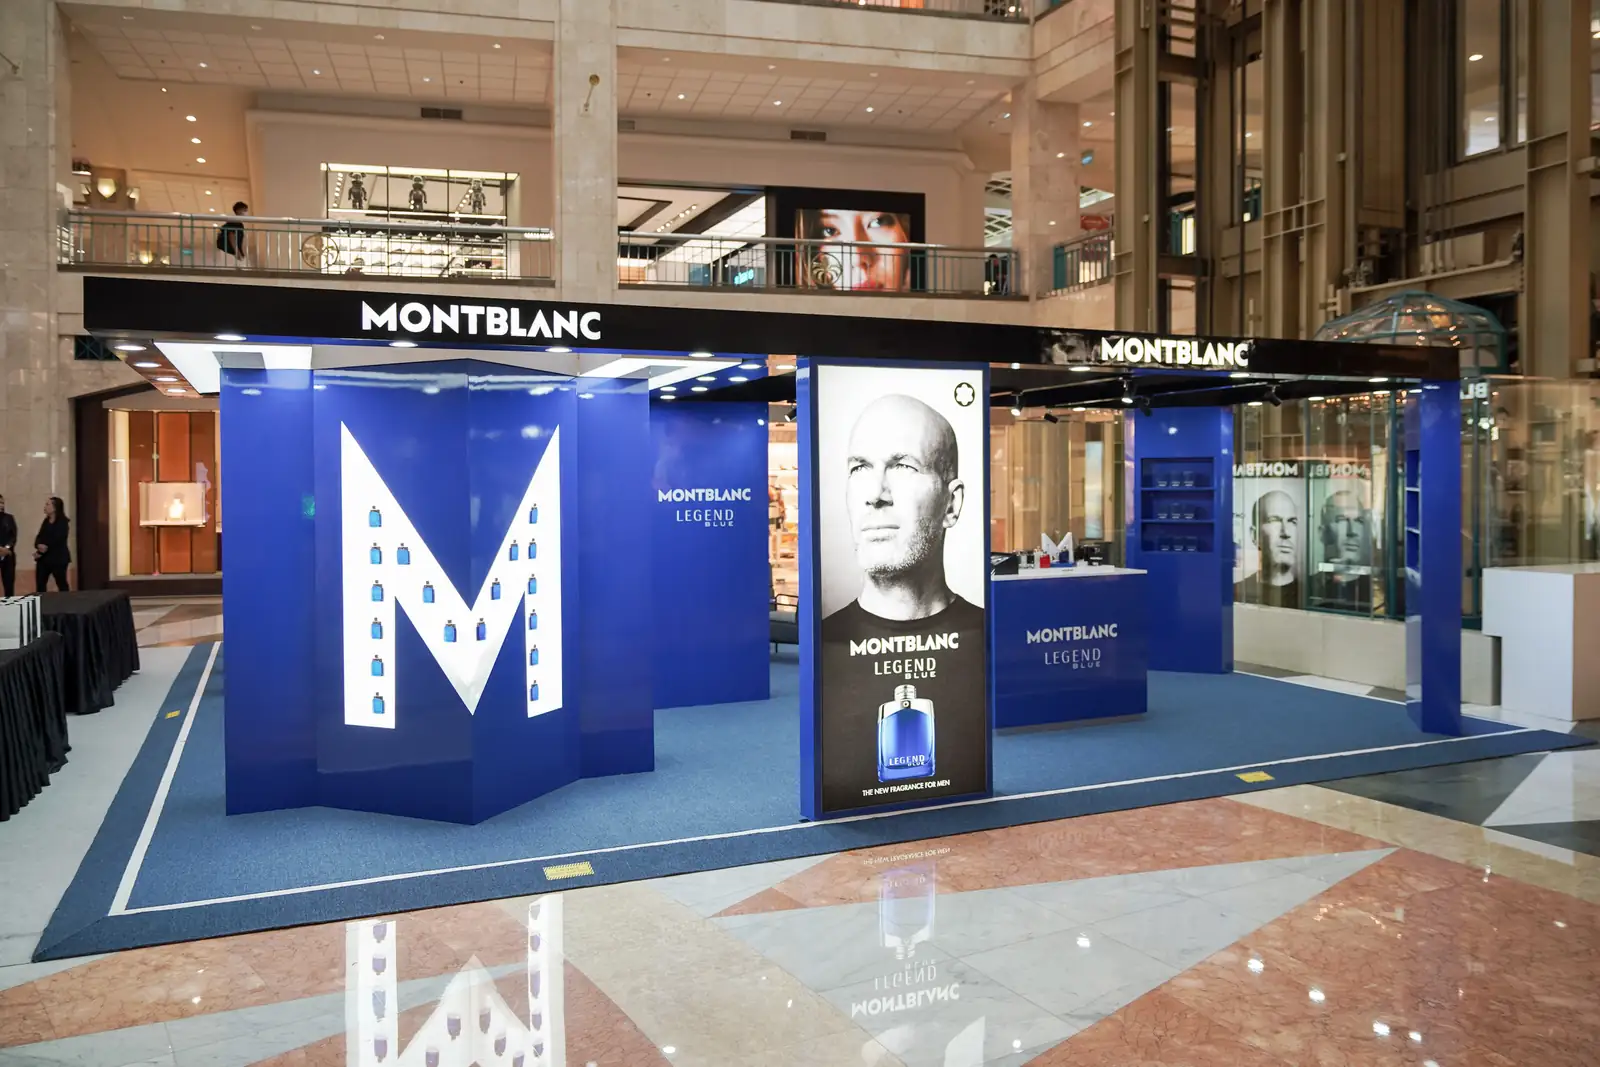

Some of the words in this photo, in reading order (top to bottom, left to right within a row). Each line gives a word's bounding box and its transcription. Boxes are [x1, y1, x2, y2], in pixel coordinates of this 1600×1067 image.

[362, 300, 601, 340] MONTBLANC
[1101, 336, 1249, 367] MONTBLANC
[658, 488, 751, 502] MONTBLANC
[676, 509, 734, 522] LEGEND
[1026, 623, 1118, 644] MONTBLANC
[849, 632, 959, 656] MONTBLANC
[1044, 648, 1101, 665] LEGEND
[874, 657, 937, 675] LEGEND
[1072, 661, 1101, 670] BLUE
[904, 671, 937, 680] BLUE
[889, 754, 925, 766] LEGEND
[862, 788, 873, 797] THE
[874, 786, 889, 795] NEW
[890, 781, 924, 793] FRAGRANCE
[937, 779, 951, 787] MEN
